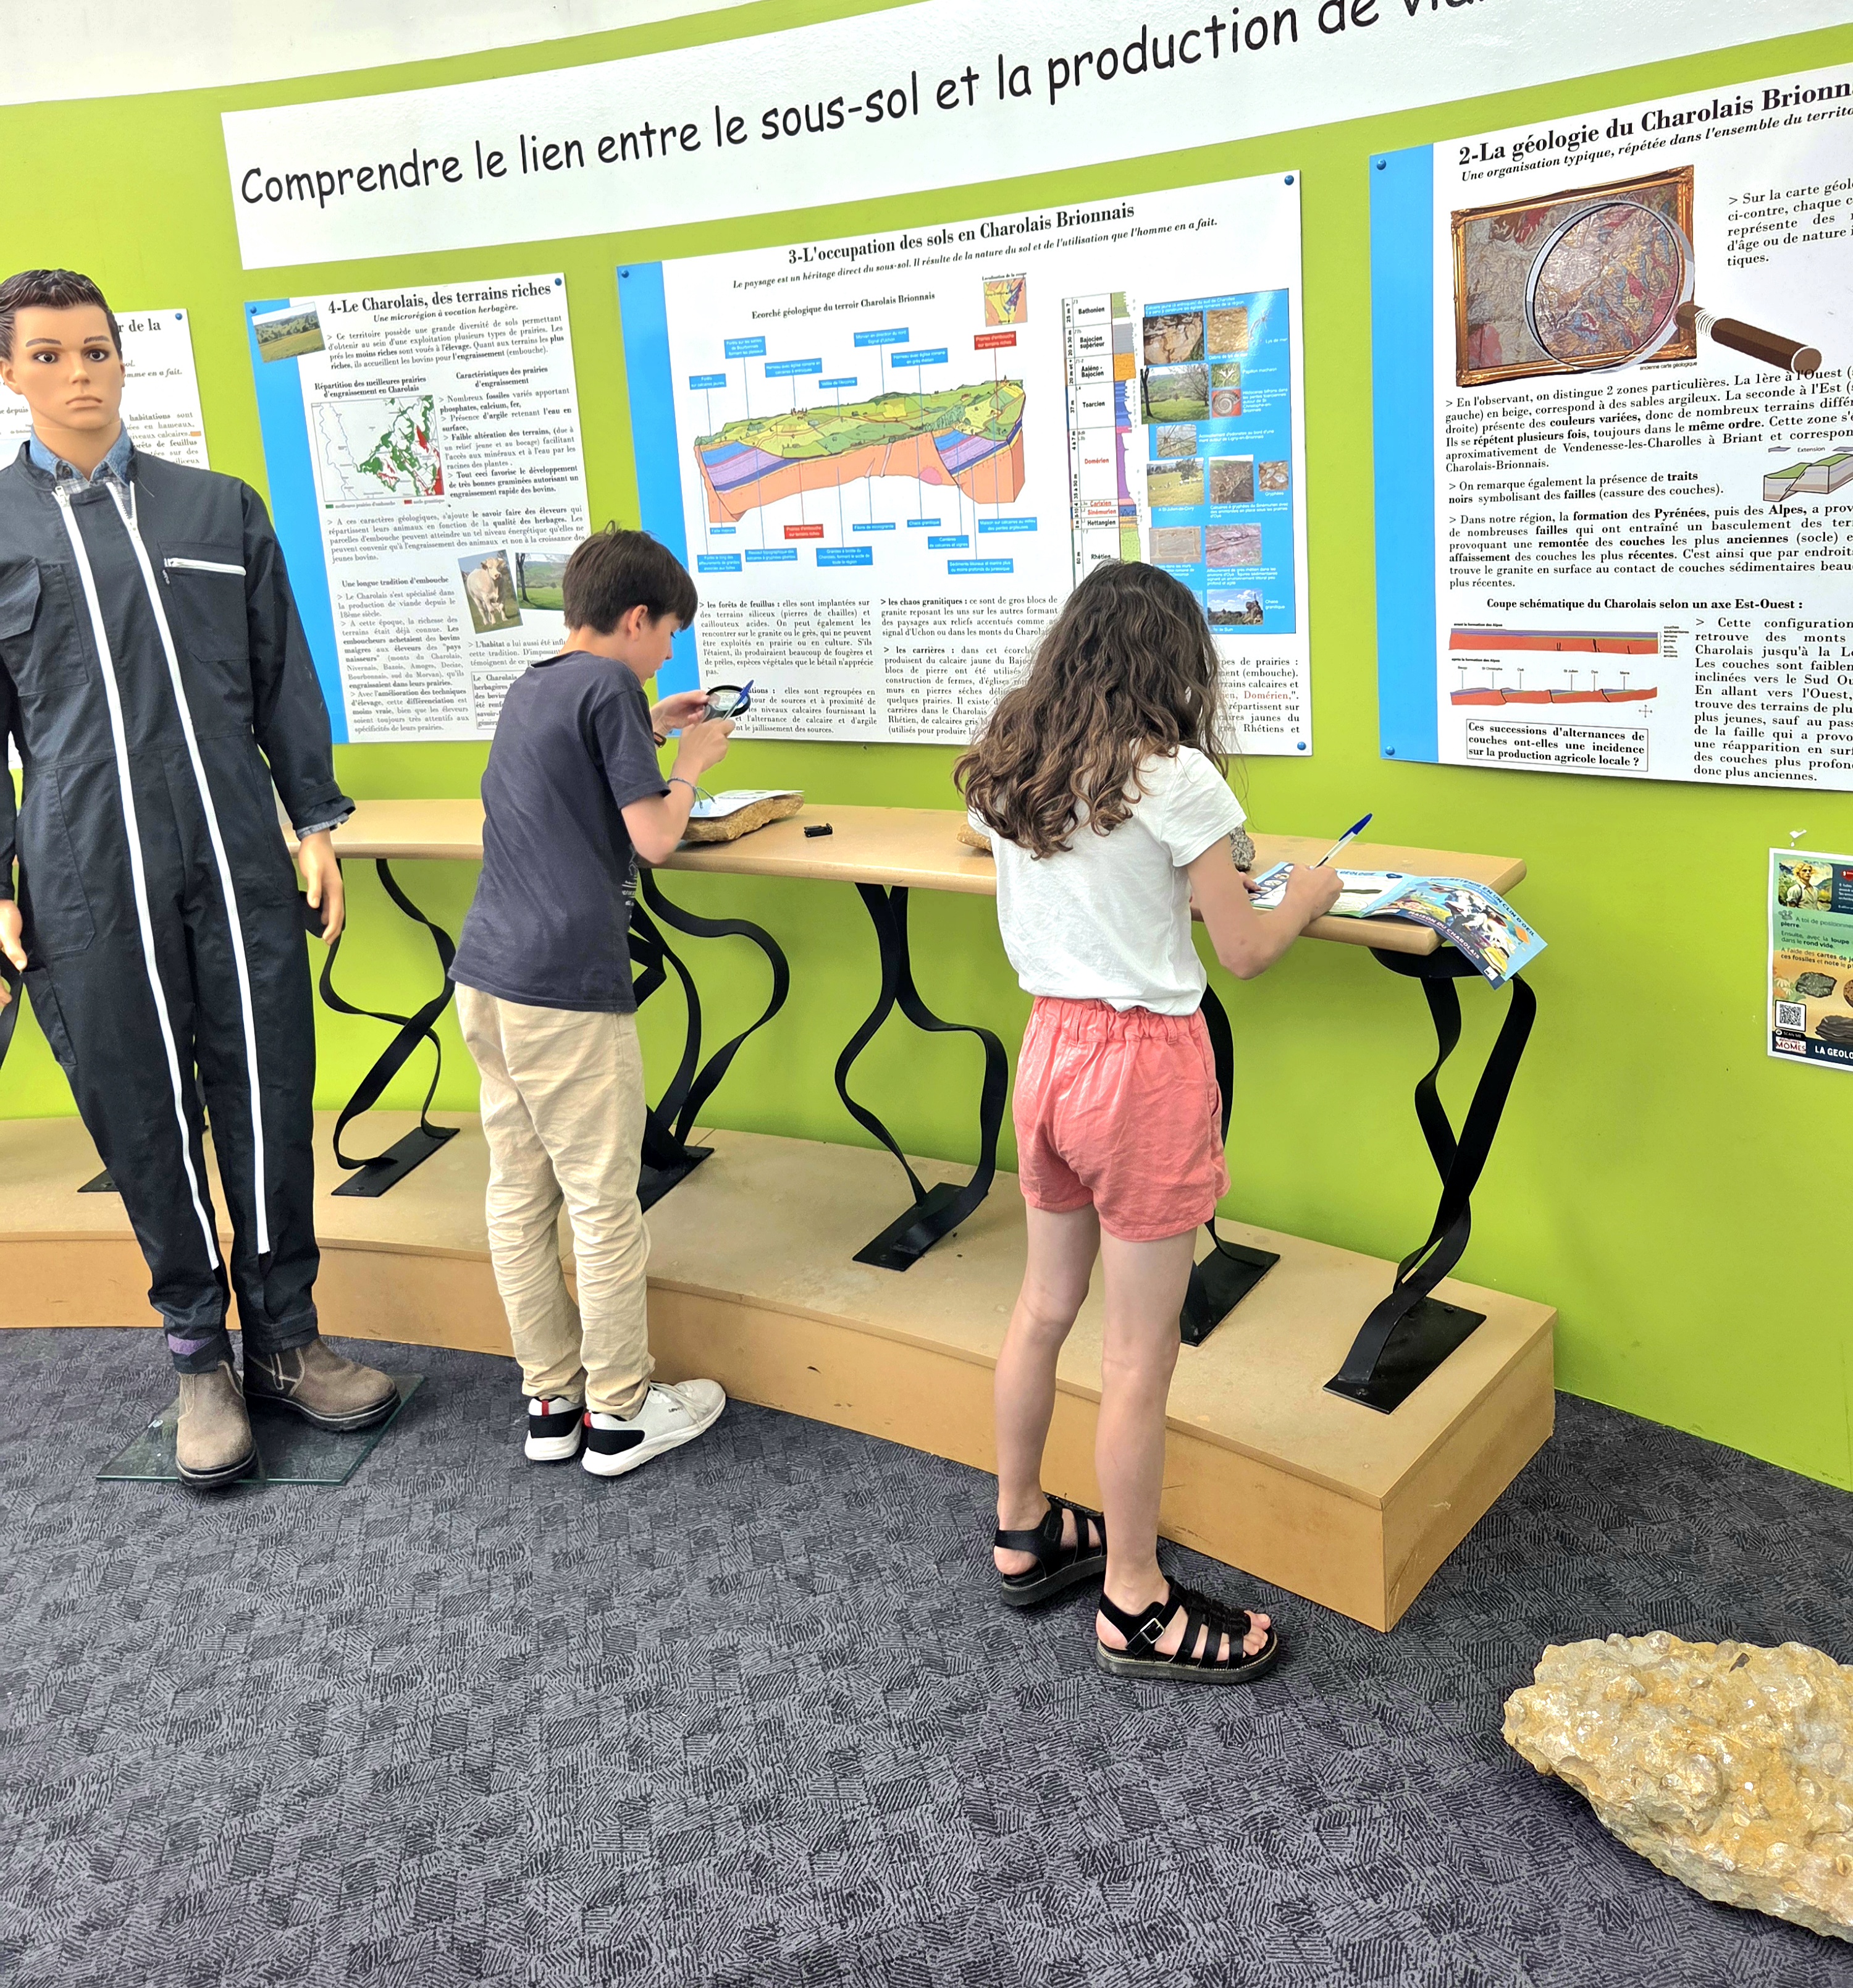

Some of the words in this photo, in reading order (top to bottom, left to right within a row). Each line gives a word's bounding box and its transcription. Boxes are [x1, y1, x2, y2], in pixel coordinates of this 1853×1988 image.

[242, 149, 462, 208] Comprendre
[476, 140, 506, 179] le
[520, 135, 584, 174] lien
[599, 122, 700, 162] entre
[715, 106, 747, 146] le
[762, 71, 917, 140] sous-sol
[937, 66, 979, 109] et
[999, 54, 1031, 99] la
[1048, 7, 1297, 105] production
[1459, 142, 1505, 165] 2-La
[1512, 124, 1599, 162] géologie
[1606, 117, 1633, 138] du
[1641, 95, 1753, 131] Charolais
[1761, 83, 1851, 111] Brionn
[1462, 171, 1483, 181] Une
[1487, 158, 1560, 178] organisation
[1564, 150, 1614, 166] typique,
[1618, 137, 1666, 156] répétée
[1670, 133, 1701, 145] dans
[1705, 117, 1779, 139] l'ensemble
[1783, 114, 1802, 125] du
[789, 238, 894, 263] 3-L'occupation
[899, 234, 922, 249] des
[926, 229, 953, 246] sols
[958, 230, 975, 241] en
[980, 214, 1051, 238] Charolais
[1056, 202, 1134, 227] Brionnais
[733, 280, 742, 288] Le
[744, 279, 775, 289] paysage
[802, 271, 835, 280] héritage
[837, 267, 860, 276] direct
[863, 264, 873, 272] du
[876, 259, 910, 271] sous-sol.
[914, 258, 920, 266] Il
[922, 255, 950, 266] résulte
[952, 252, 962, 261] de
[965, 251, 972, 259] la
[975, 250, 1002, 258] nature
[1005, 245, 1015, 254] du
[1019, 242, 1031, 252] sol
[1043, 240, 1054, 248] de
[1056, 234, 1108, 247] l'utilisation
[1111, 232, 1128, 242] que
[1130, 225, 1172, 237] l'homme
[1196, 216, 1217, 231] fait.
[328, 299, 358, 313] 4-Le
[362, 293, 428, 311] Charolais,
[432, 291, 452, 305] des
[456, 287, 508, 302] terrains
[511, 282, 550, 297] riches
[752, 309, 780, 319] Ecorché
[783, 306, 821, 318] géologique
[823, 303, 833, 311] du
[834, 300, 859, 310] terroir
[860, 296, 896, 306] Charolais
[897, 292, 935, 303] Brionnais
[390, 311, 435, 321] microrégion
[444, 307, 476, 316] vocation
[478, 303, 518, 313] herbagère.
[1078, 306, 1105, 314] Bathonien
[1487, 598, 1516, 610] Coupe
[1519, 599, 1584, 610] schématique
[1587, 599, 1600, 608] du
[1604, 599, 1656, 608] Charolais
[1659, 599, 1688, 608] selon
[1735, 598, 1794, 609] Est-Ouest
[1240, 657, 1250, 665] de
[1256, 657, 1289, 668] prairies
[1243, 668, 1298, 678] (embouche).
[348, 681, 391, 690] engraissaient
[426, 679, 452, 688] prairies.
[1248, 679, 1287, 688] calcaires
[1228, 702, 1281, 712] répartissent
[1243, 723, 1284, 732] Rhétiens
[1468, 722, 1484, 731] Ces
[1490, 725, 1547, 735] successions
[1553, 727, 1624, 739] d'alternances
[1631, 731, 1644, 741] de
[1468, 735, 1506, 744] couches
[1514, 738, 1558, 748] ont-elles
[1592, 742, 1644, 754] incidence
[1486, 748, 1495, 756] la
[1498, 749, 1551, 762] production
[1554, 753, 1595, 764] agricole
[1599, 754, 1630, 765] locale
[1633, 757, 1639, 765] ?
[1694, 764, 1721, 775] donc
[1725, 767, 1749, 778] plus
[1754, 769, 1817, 780] anciennes.
[1482, 885, 1493, 895] EN
[1493, 894, 1502, 904] UN
[1502, 903, 1516, 918] CLIN
[1516, 917, 1535, 937] D'OEIL
[1408, 911, 1436, 924] MAISON
[1436, 921, 1447, 930] DU
[1447, 928, 1480, 959] CHAROLAIS
